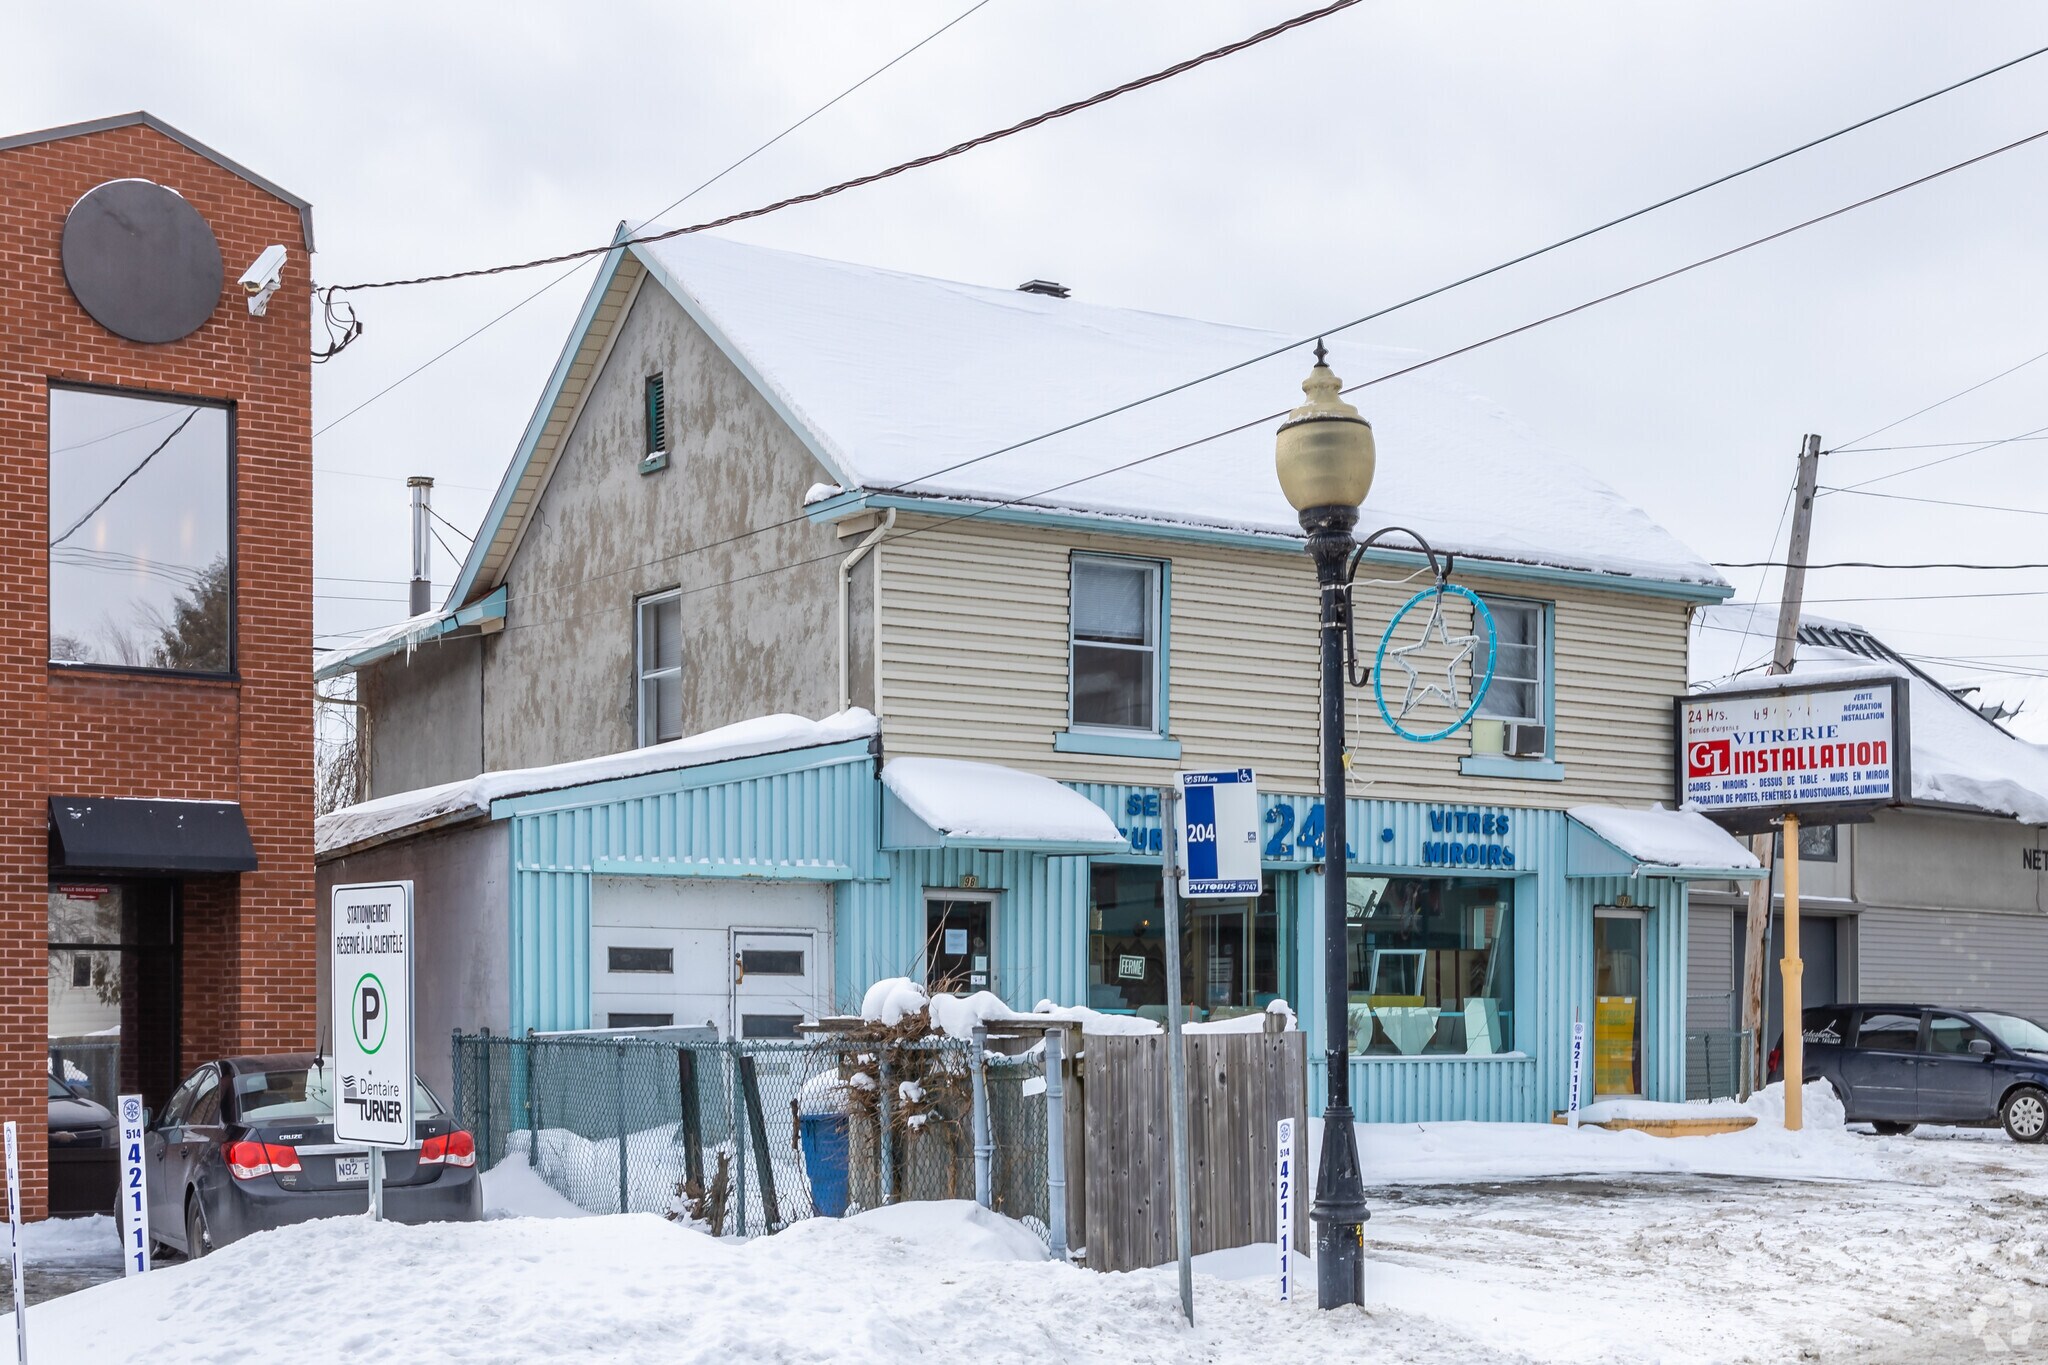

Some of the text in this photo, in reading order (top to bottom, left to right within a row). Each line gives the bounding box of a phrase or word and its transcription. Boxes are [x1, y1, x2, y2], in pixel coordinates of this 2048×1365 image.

[1843, 702, 1882, 711] RÉPARATION
[1688, 710, 1702, 723] 24
[1841, 712, 1885, 721] INSTALLATION
[1689, 726, 1709, 734] Service
[1733, 725, 1838, 745] VITRERIE
[1688, 782, 1711, 792] CADRES
[1722, 779, 1748, 790] MIROIRS
[1760, 777, 1783, 787] DESSUS
[1787, 776, 1795, 786] DE
[1800, 774, 1818, 784] TABLE
[1830, 772, 1849, 783] MURS
[1853, 771, 1861, 781] EN
[1866, 769, 1890, 780] MIROIR
[1726, 794, 1733, 803] DE
[1735, 792, 1760, 803] PORTES,
[1793, 789, 1798, 799] &
[1800, 786, 1852, 798] MOUSTIQUAIRES,
[1853, 783, 1890, 795] ALUMINIUM
[1430, 810, 1509, 836] VITRES
[1188, 824, 1215, 842] 204
[1423, 841, 1516, 866] MIROIRS
[964, 877, 975, 887] 98
[1189, 883, 1257, 891] AUTOBUS 57747
[347, 904, 391, 924] STATIONNEMENT
[337, 930, 403, 954] RÉSERVÉ À LA CLIENTÈLE
[362, 987, 380, 1040] P
[360, 1078, 399, 1097] Dentaire
[359, 1099, 402, 1123] TURNER
[126, 1129, 141, 1139] 514
[1279, 1148, 1290, 1157] 514
[338, 1163, 359, 1176] N92
